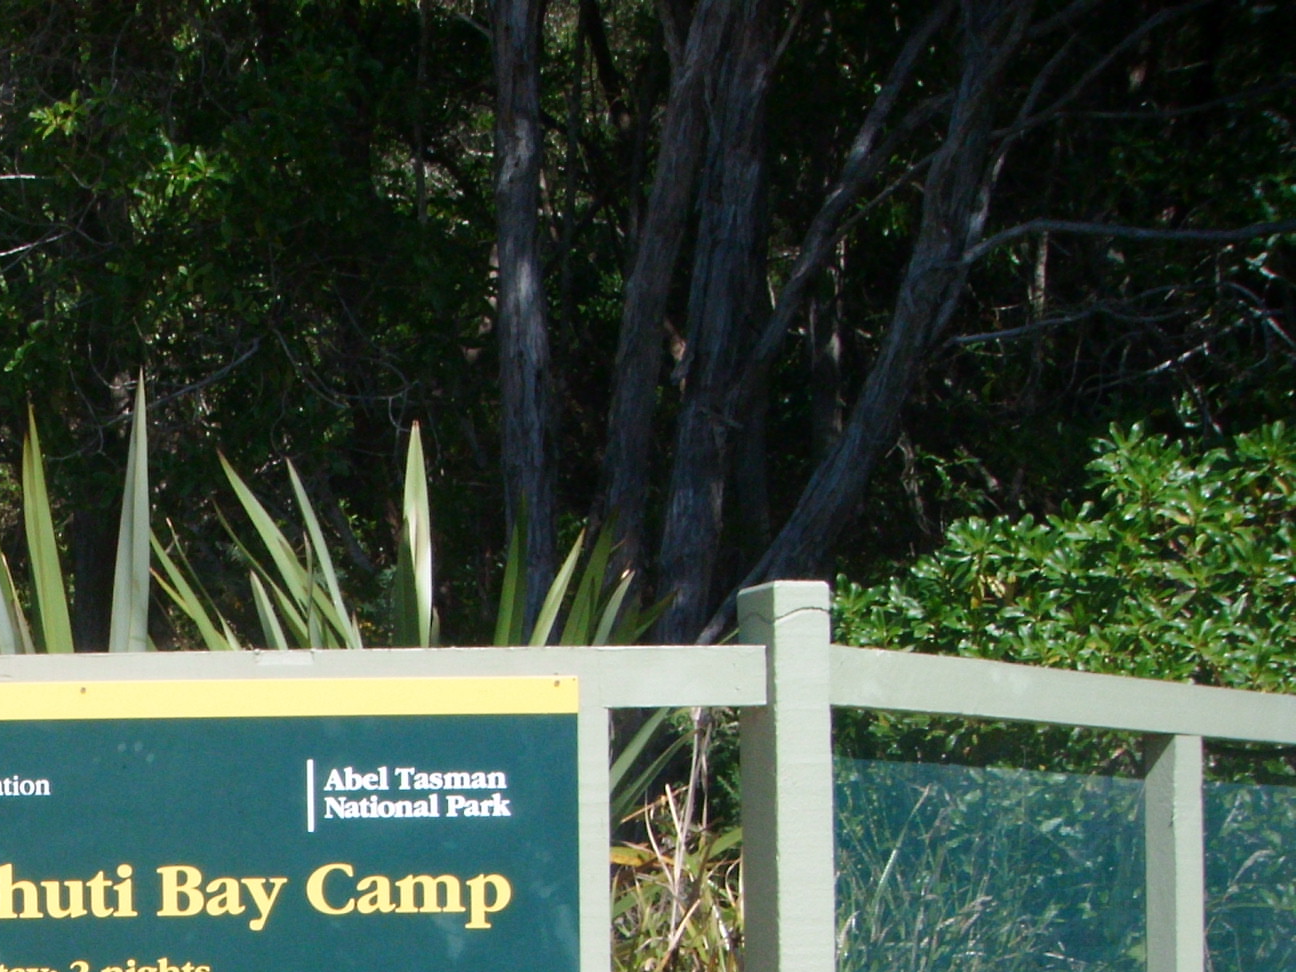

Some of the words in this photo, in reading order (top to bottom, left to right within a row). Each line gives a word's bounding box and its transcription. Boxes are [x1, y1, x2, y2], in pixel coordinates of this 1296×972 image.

[323, 766, 389, 791] Abel
[395, 767, 507, 790] Tasman
[324, 793, 440, 819] National
[446, 792, 511, 817] Park
[156, 865, 288, 931] Bay
[306, 862, 512, 929] Camp
